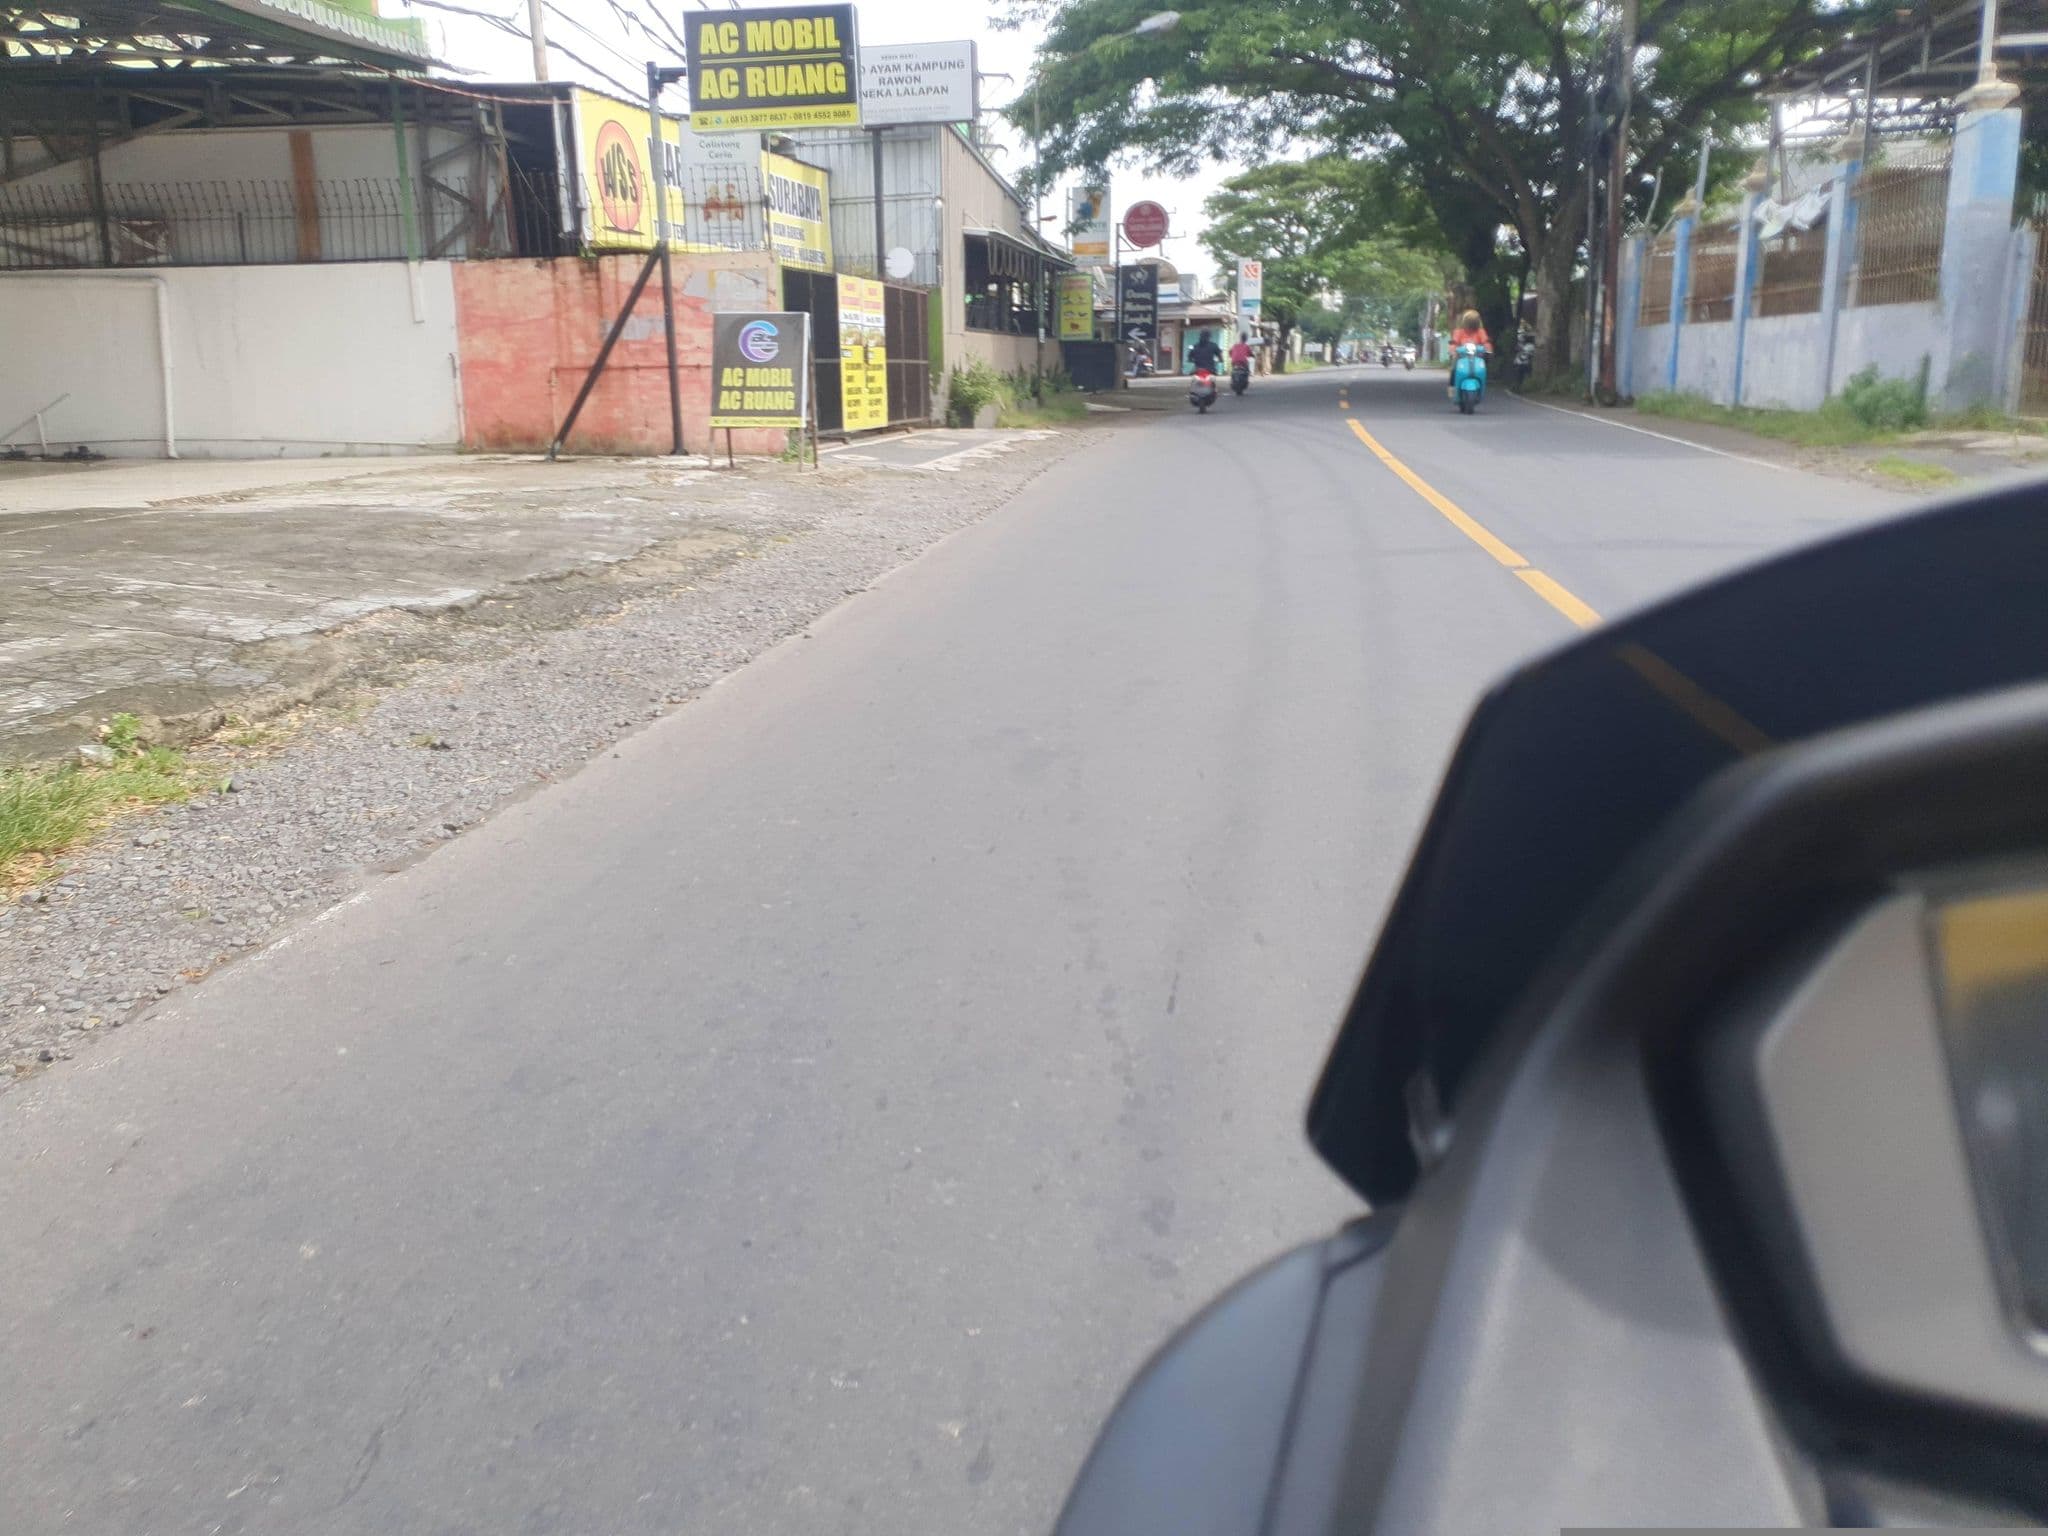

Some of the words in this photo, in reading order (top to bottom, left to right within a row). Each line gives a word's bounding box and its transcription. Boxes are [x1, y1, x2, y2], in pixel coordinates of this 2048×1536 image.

[700, 21, 740, 55] AC
[745, 16, 841, 53] MOBIL
[870, 64, 902, 74] AYAM
[905, 60, 966, 73] KAMPUNG
[700, 67, 740, 100] AC
[745, 61, 847, 98] RUANG
[878, 75, 922, 86] RAWON
[861, 88, 893, 99] NEKA
[896, 85, 949, 97] LALAPAN
[769, 173, 823, 222] SURABAYA
[721, 367, 744, 387] AC
[746, 367, 794, 387] MOBIL
[719, 390, 742, 410] AC
[743, 390, 796, 411] RUANG
